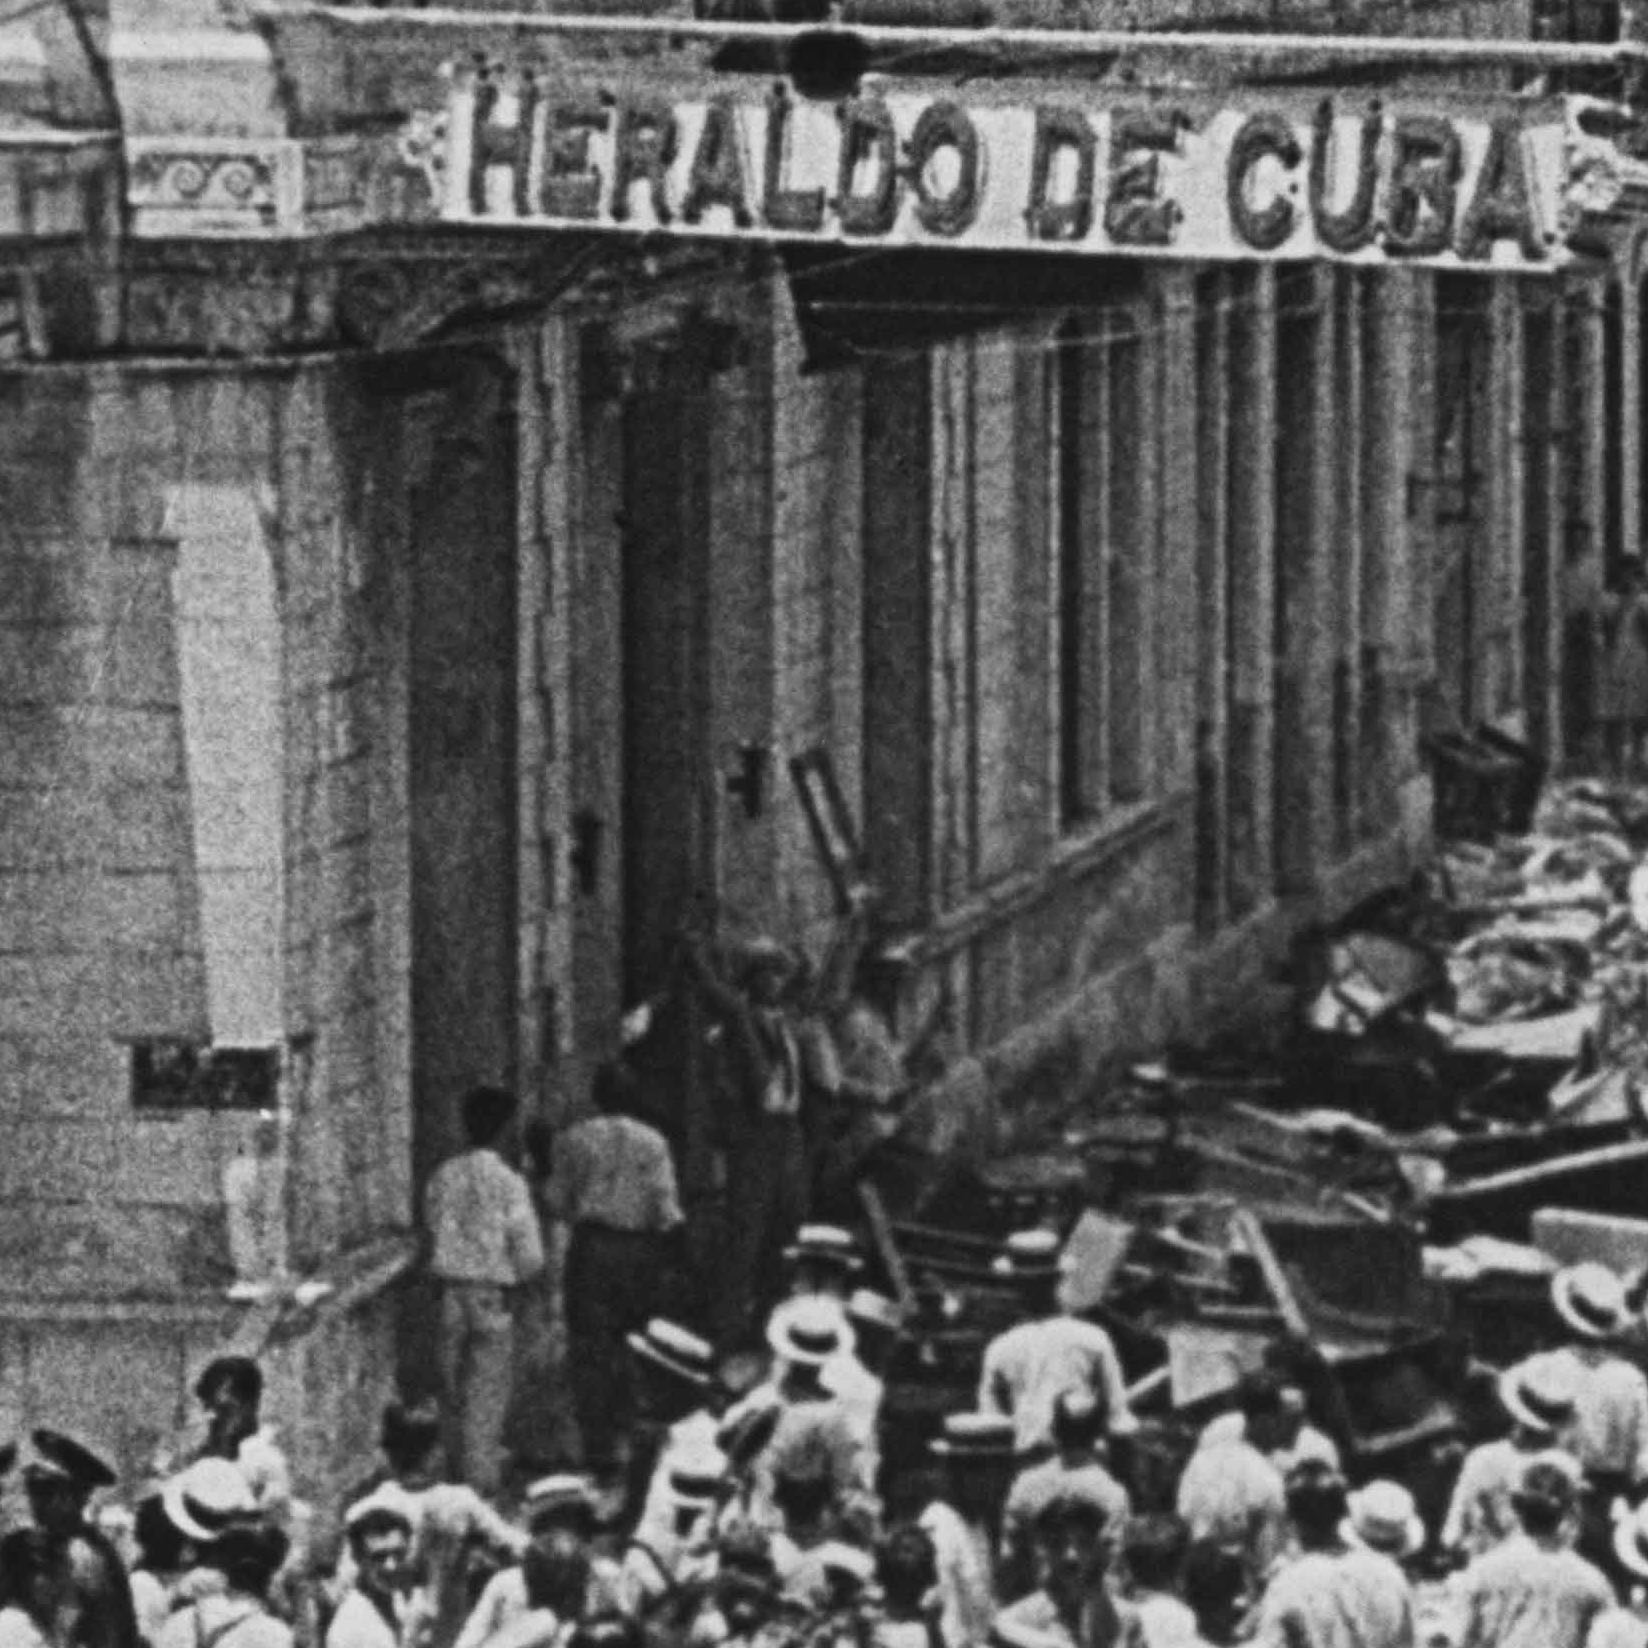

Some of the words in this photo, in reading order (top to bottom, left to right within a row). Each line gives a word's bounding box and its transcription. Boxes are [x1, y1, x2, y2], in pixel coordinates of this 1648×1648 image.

[468, 80, 978, 236] HERALDO
[1025, 104, 1182, 244] DE
[1228, 98, 1554, 260] CUBA
